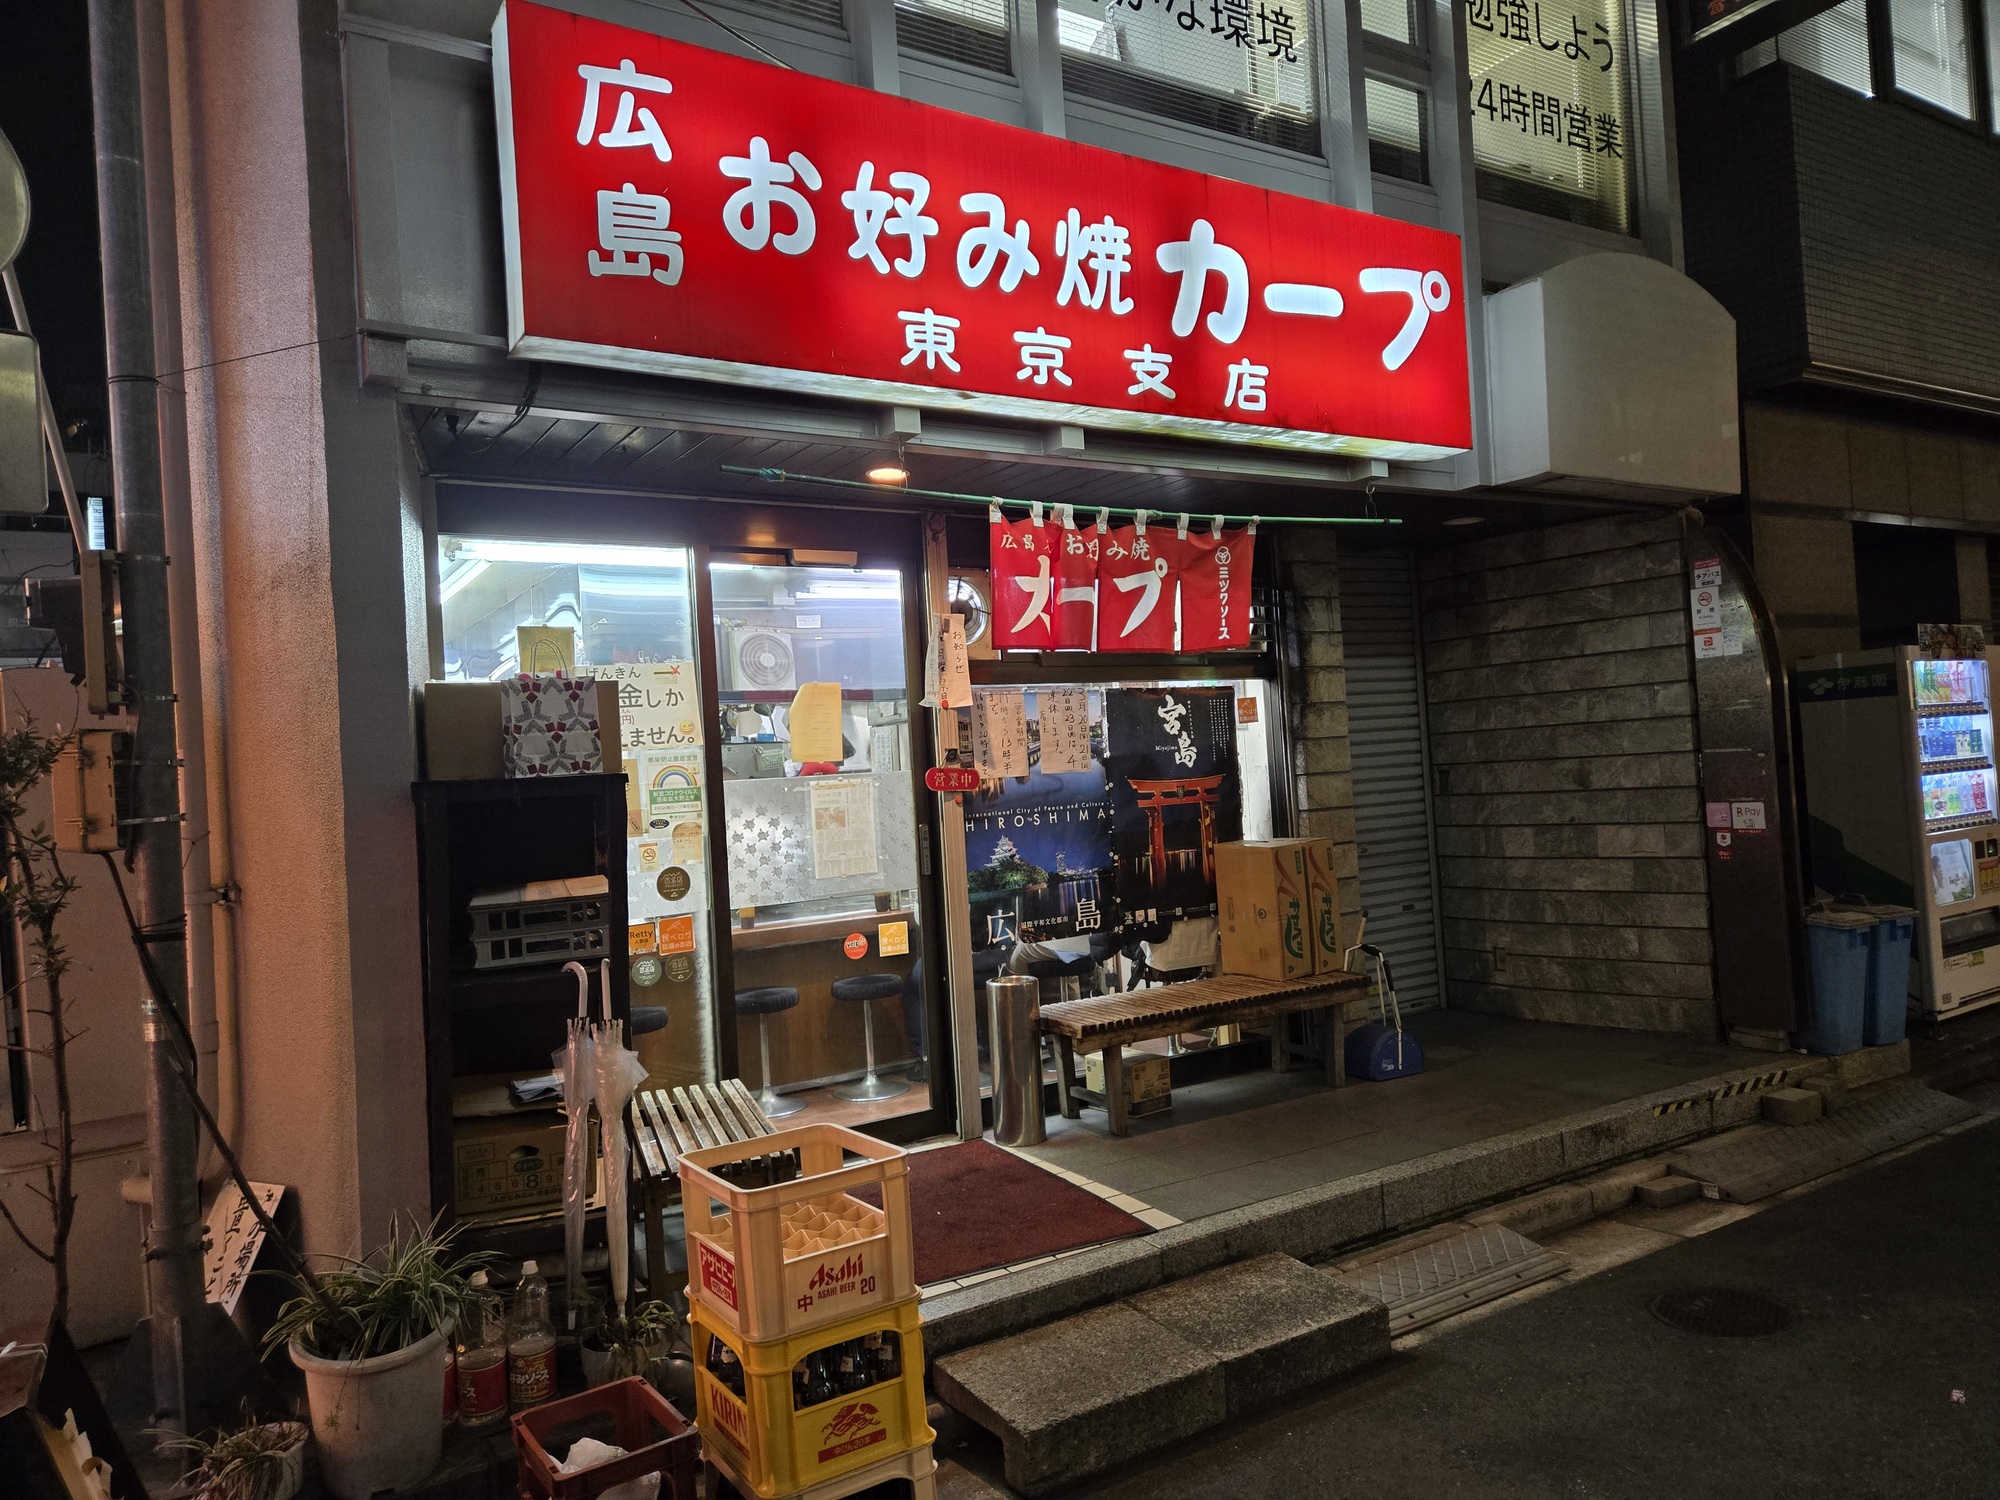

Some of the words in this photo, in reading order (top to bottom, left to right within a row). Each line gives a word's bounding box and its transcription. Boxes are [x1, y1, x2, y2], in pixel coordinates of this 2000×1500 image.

[1470, 74, 1623, 159] 4時間営業
[577, 58, 684, 287] 広島
[897, 307, 1270, 412] 東京支店
[1158, 694, 1197, 768] 宮島
[934, 772, 972, 787] 営業中
[965, 808, 1106, 832] HIROSHIMA
[1745, 807, 1760, 816] Pay
[661, 932, 691, 943] 食べログ
[526, 1174, 539, 1189] 8
[809, 1253, 863, 1291] Asahi
[817, 1286, 837, 1300] ASAHI
[840, 1281, 856, 1294] BEER
[797, 1294, 813, 1312] 中
[860, 1275, 876, 1295] 20
[710, 1383, 749, 1444] KIRIN
